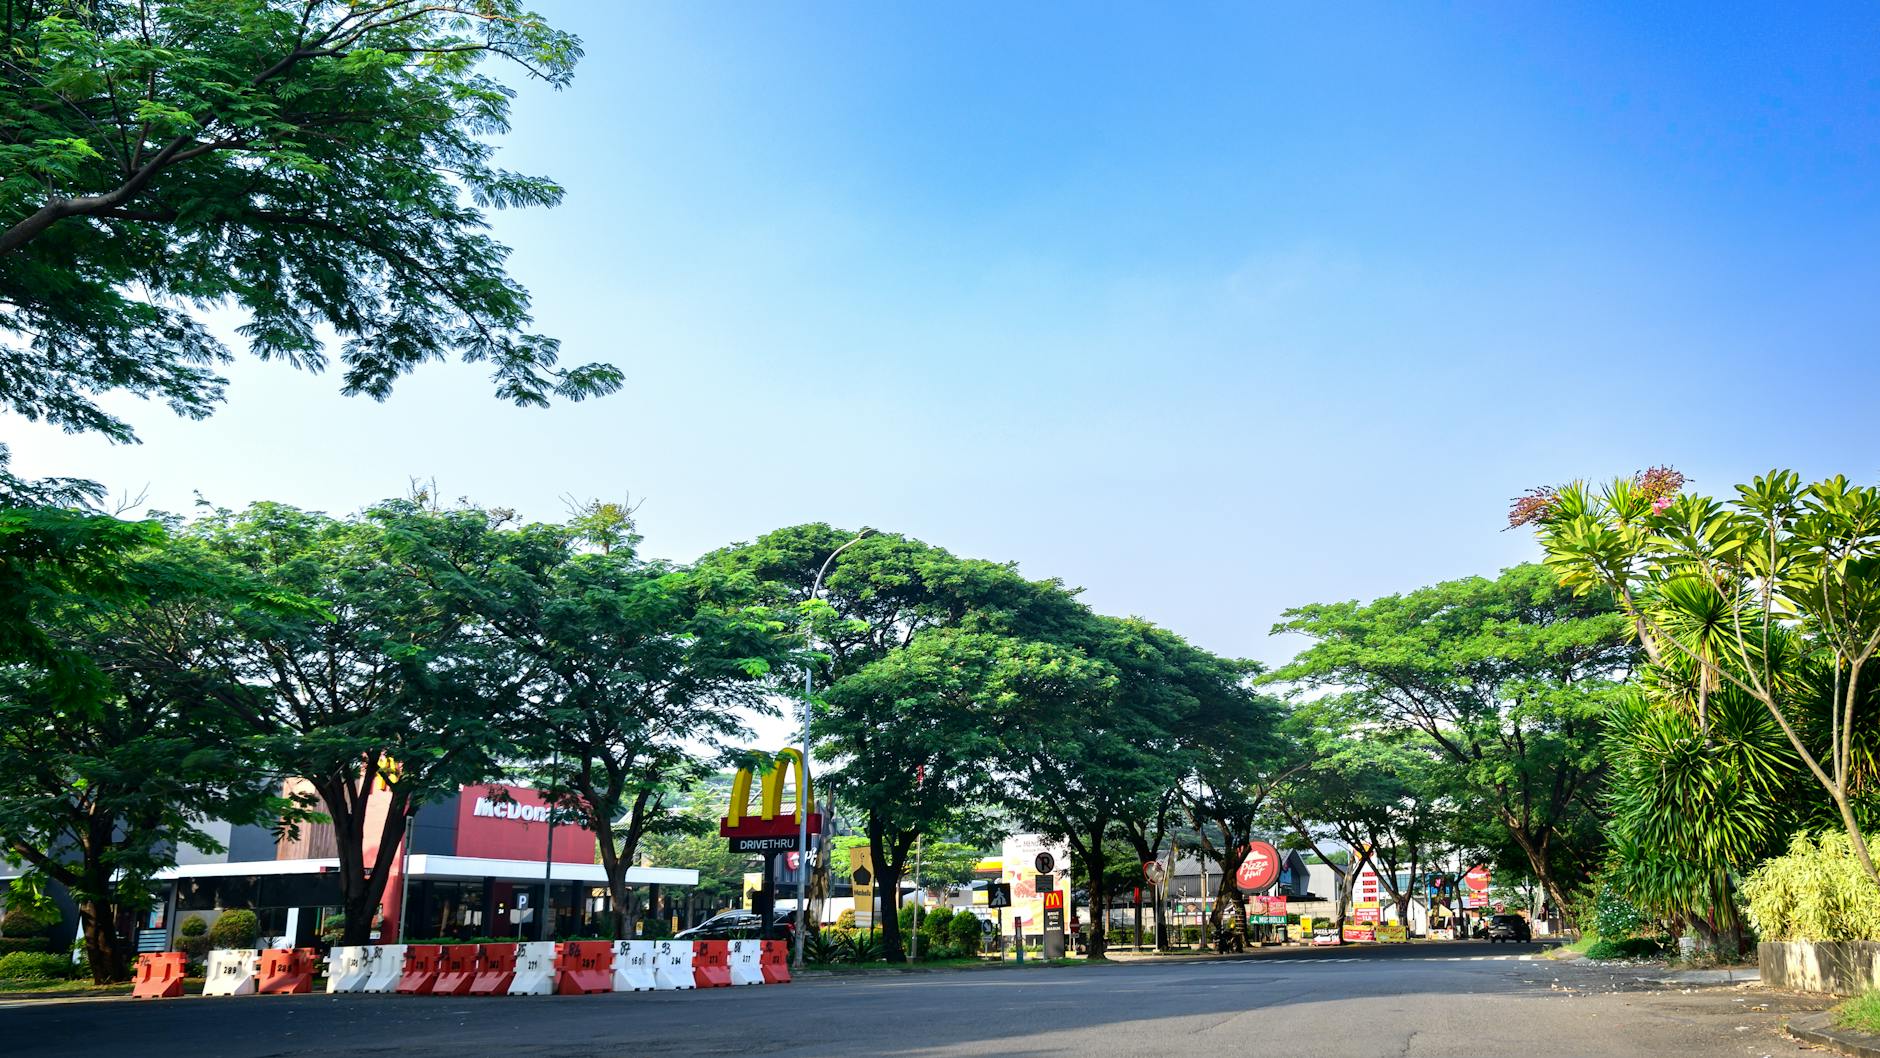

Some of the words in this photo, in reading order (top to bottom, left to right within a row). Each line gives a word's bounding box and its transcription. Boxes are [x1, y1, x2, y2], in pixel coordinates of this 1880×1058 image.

[1240, 861, 1268, 876] Pizza
[1244, 868, 1265, 880] Hut
[517, 895, 526, 908] P
